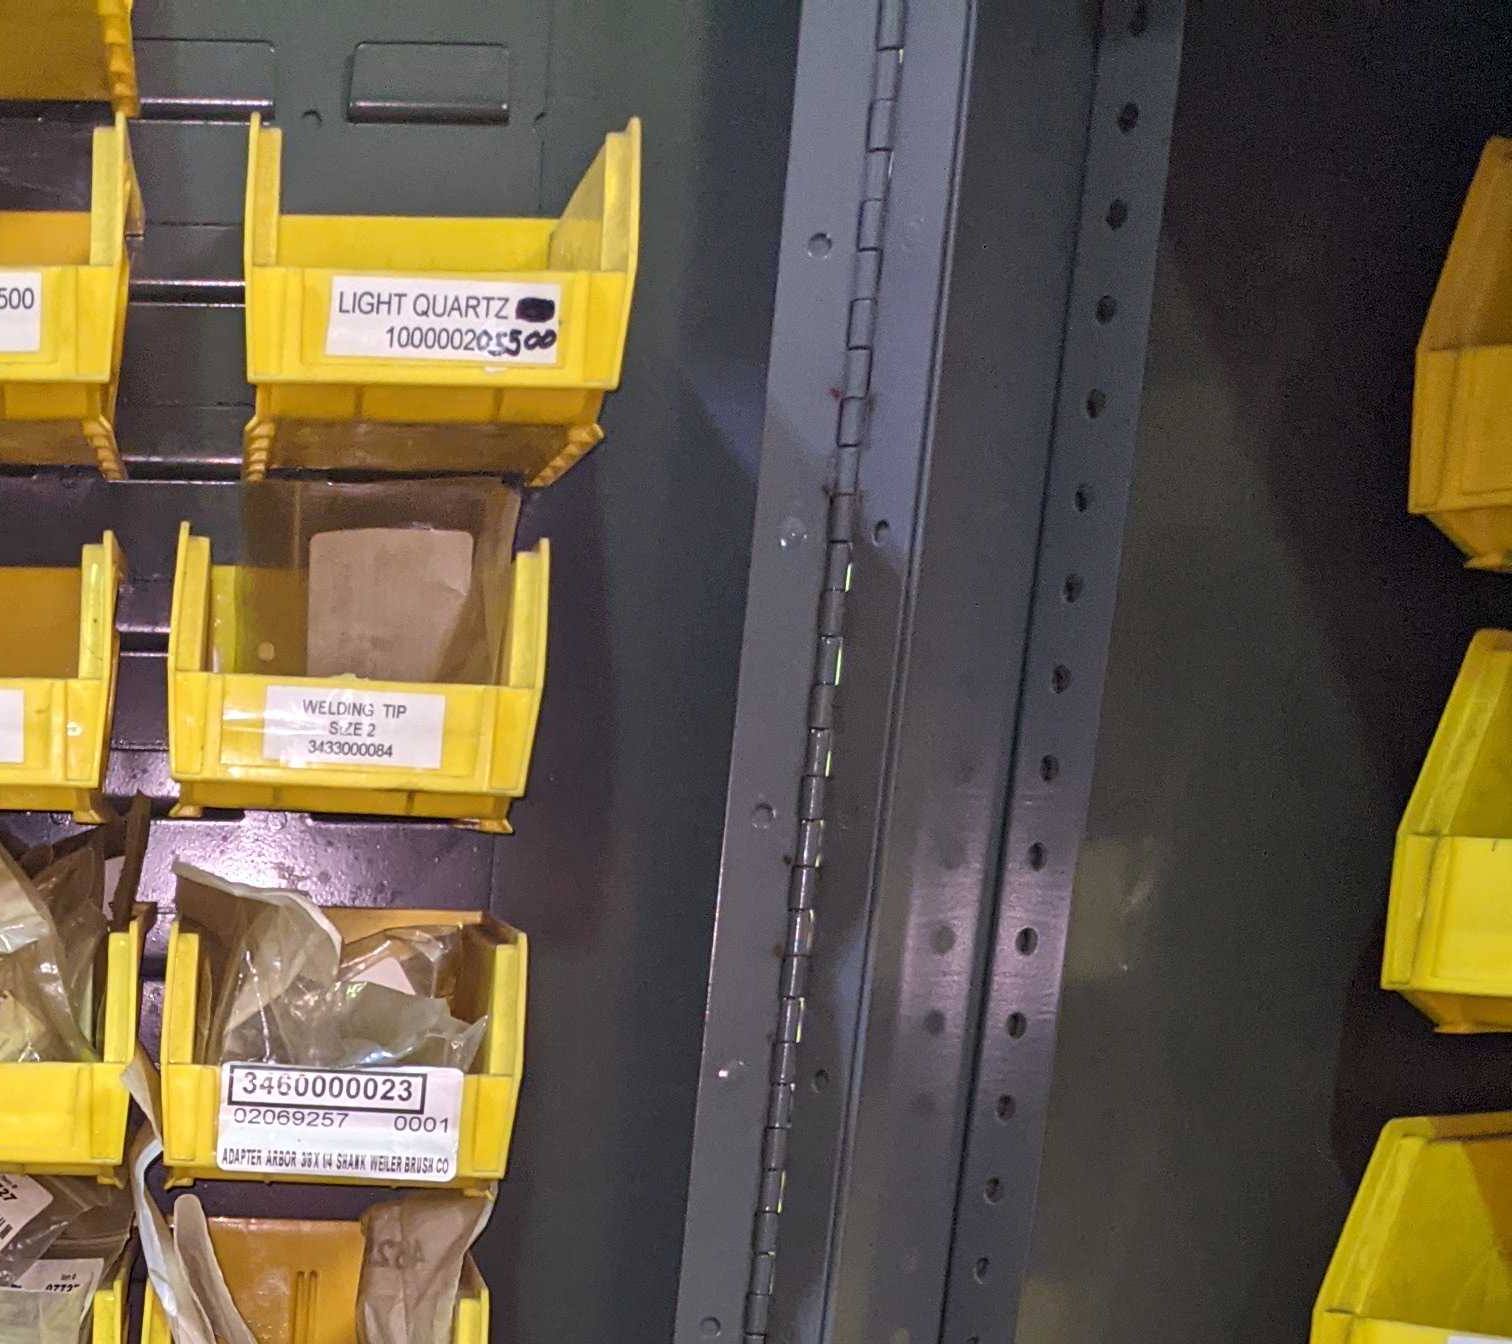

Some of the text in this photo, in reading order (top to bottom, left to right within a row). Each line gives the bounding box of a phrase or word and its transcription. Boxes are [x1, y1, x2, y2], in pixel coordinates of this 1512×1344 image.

[338, 291, 510, 320] LIGHT QUARTZ
[303, 699, 407, 719] WELDING TIP
[329, 721, 376, 737] SIZE 2
[308, 740, 393, 758] 3433000084
[242, 1071, 414, 1101] 3460000023
[234, 1108, 449, 1133] 02069257 0001
[221, 1148, 262, 1166] ADAPTER
[265, 1150, 297, 1168] ARBOR
[370, 1156, 402, 1172] WEILER
[404, 1157, 434, 1174] BRUSH
[436, 1158, 449, 1174] CO
